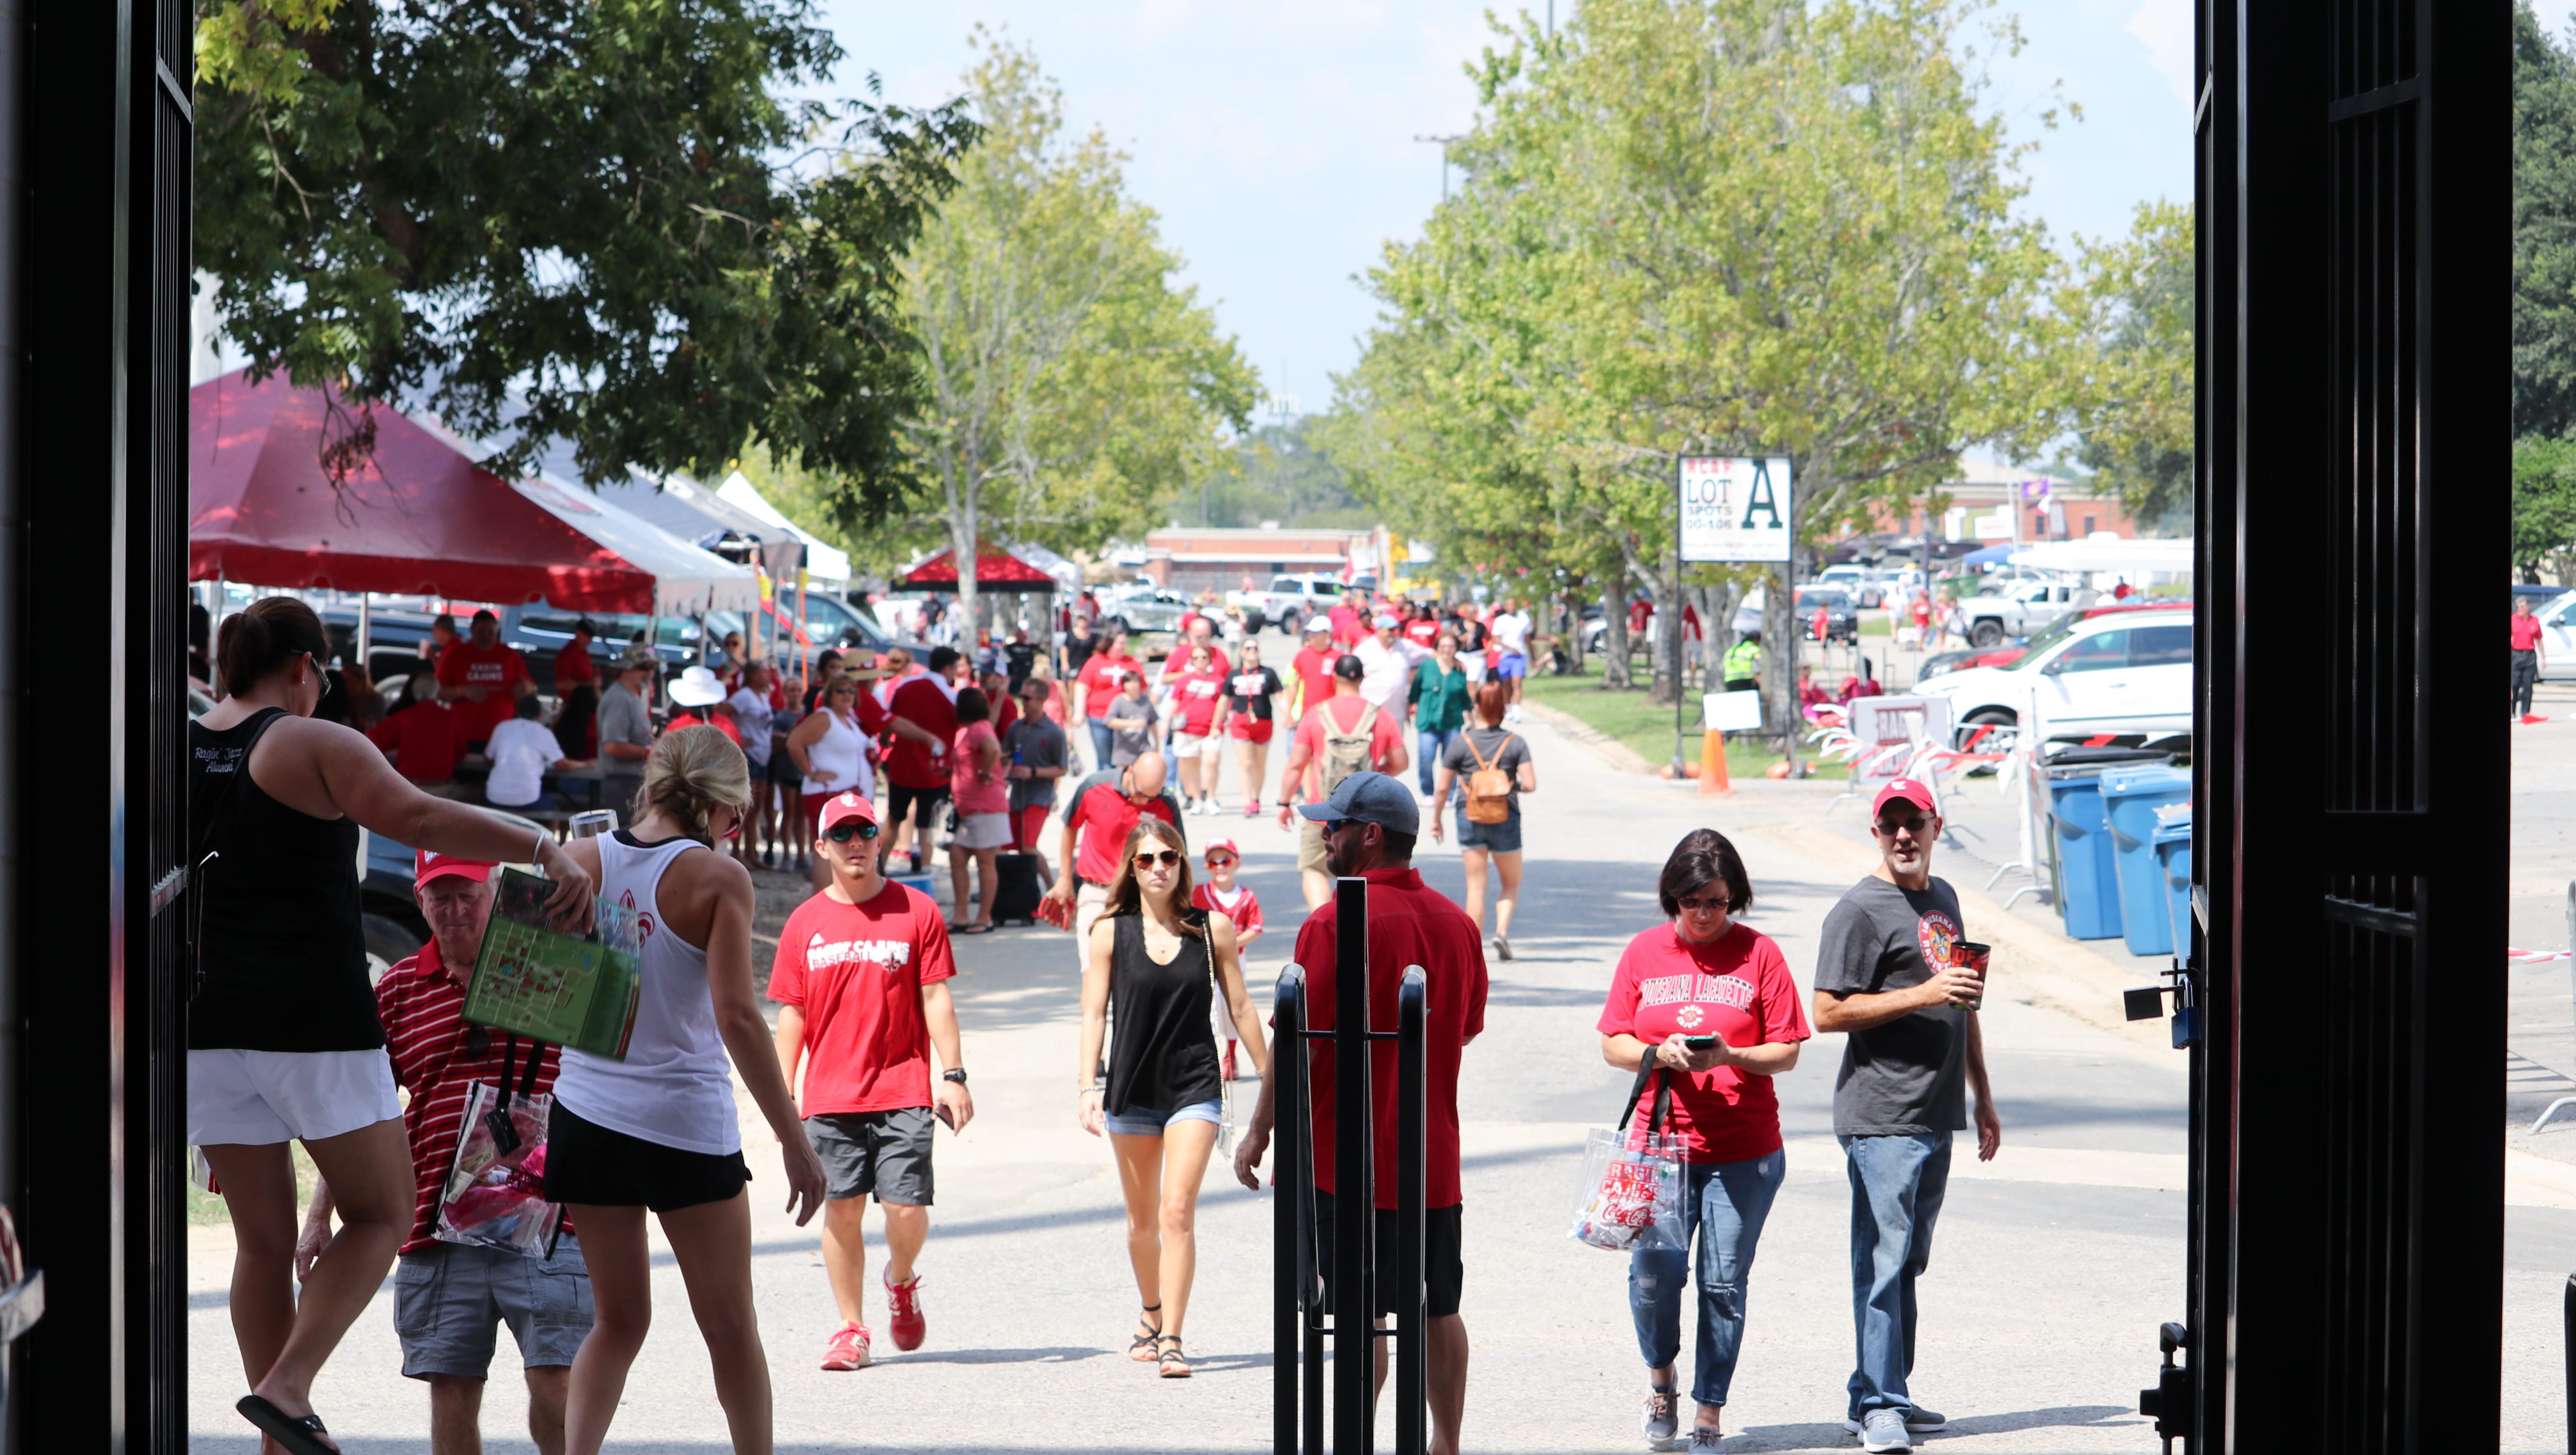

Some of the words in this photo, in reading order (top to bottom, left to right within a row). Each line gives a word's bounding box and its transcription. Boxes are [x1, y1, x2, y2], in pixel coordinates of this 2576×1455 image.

[1686, 479, 1732, 503] LOT
[1741, 457, 1783, 529] A
[1686, 505, 1732, 516] SPOTS
[224, 748, 242, 760] Jazz
[206, 760, 234, 773] Alumni
[1922, 914, 1953, 934] LOUISIANA
[1638, 974, 1693, 1011] LOUISIANA
[1693, 974, 1755, 1012] LAFAYETTE
